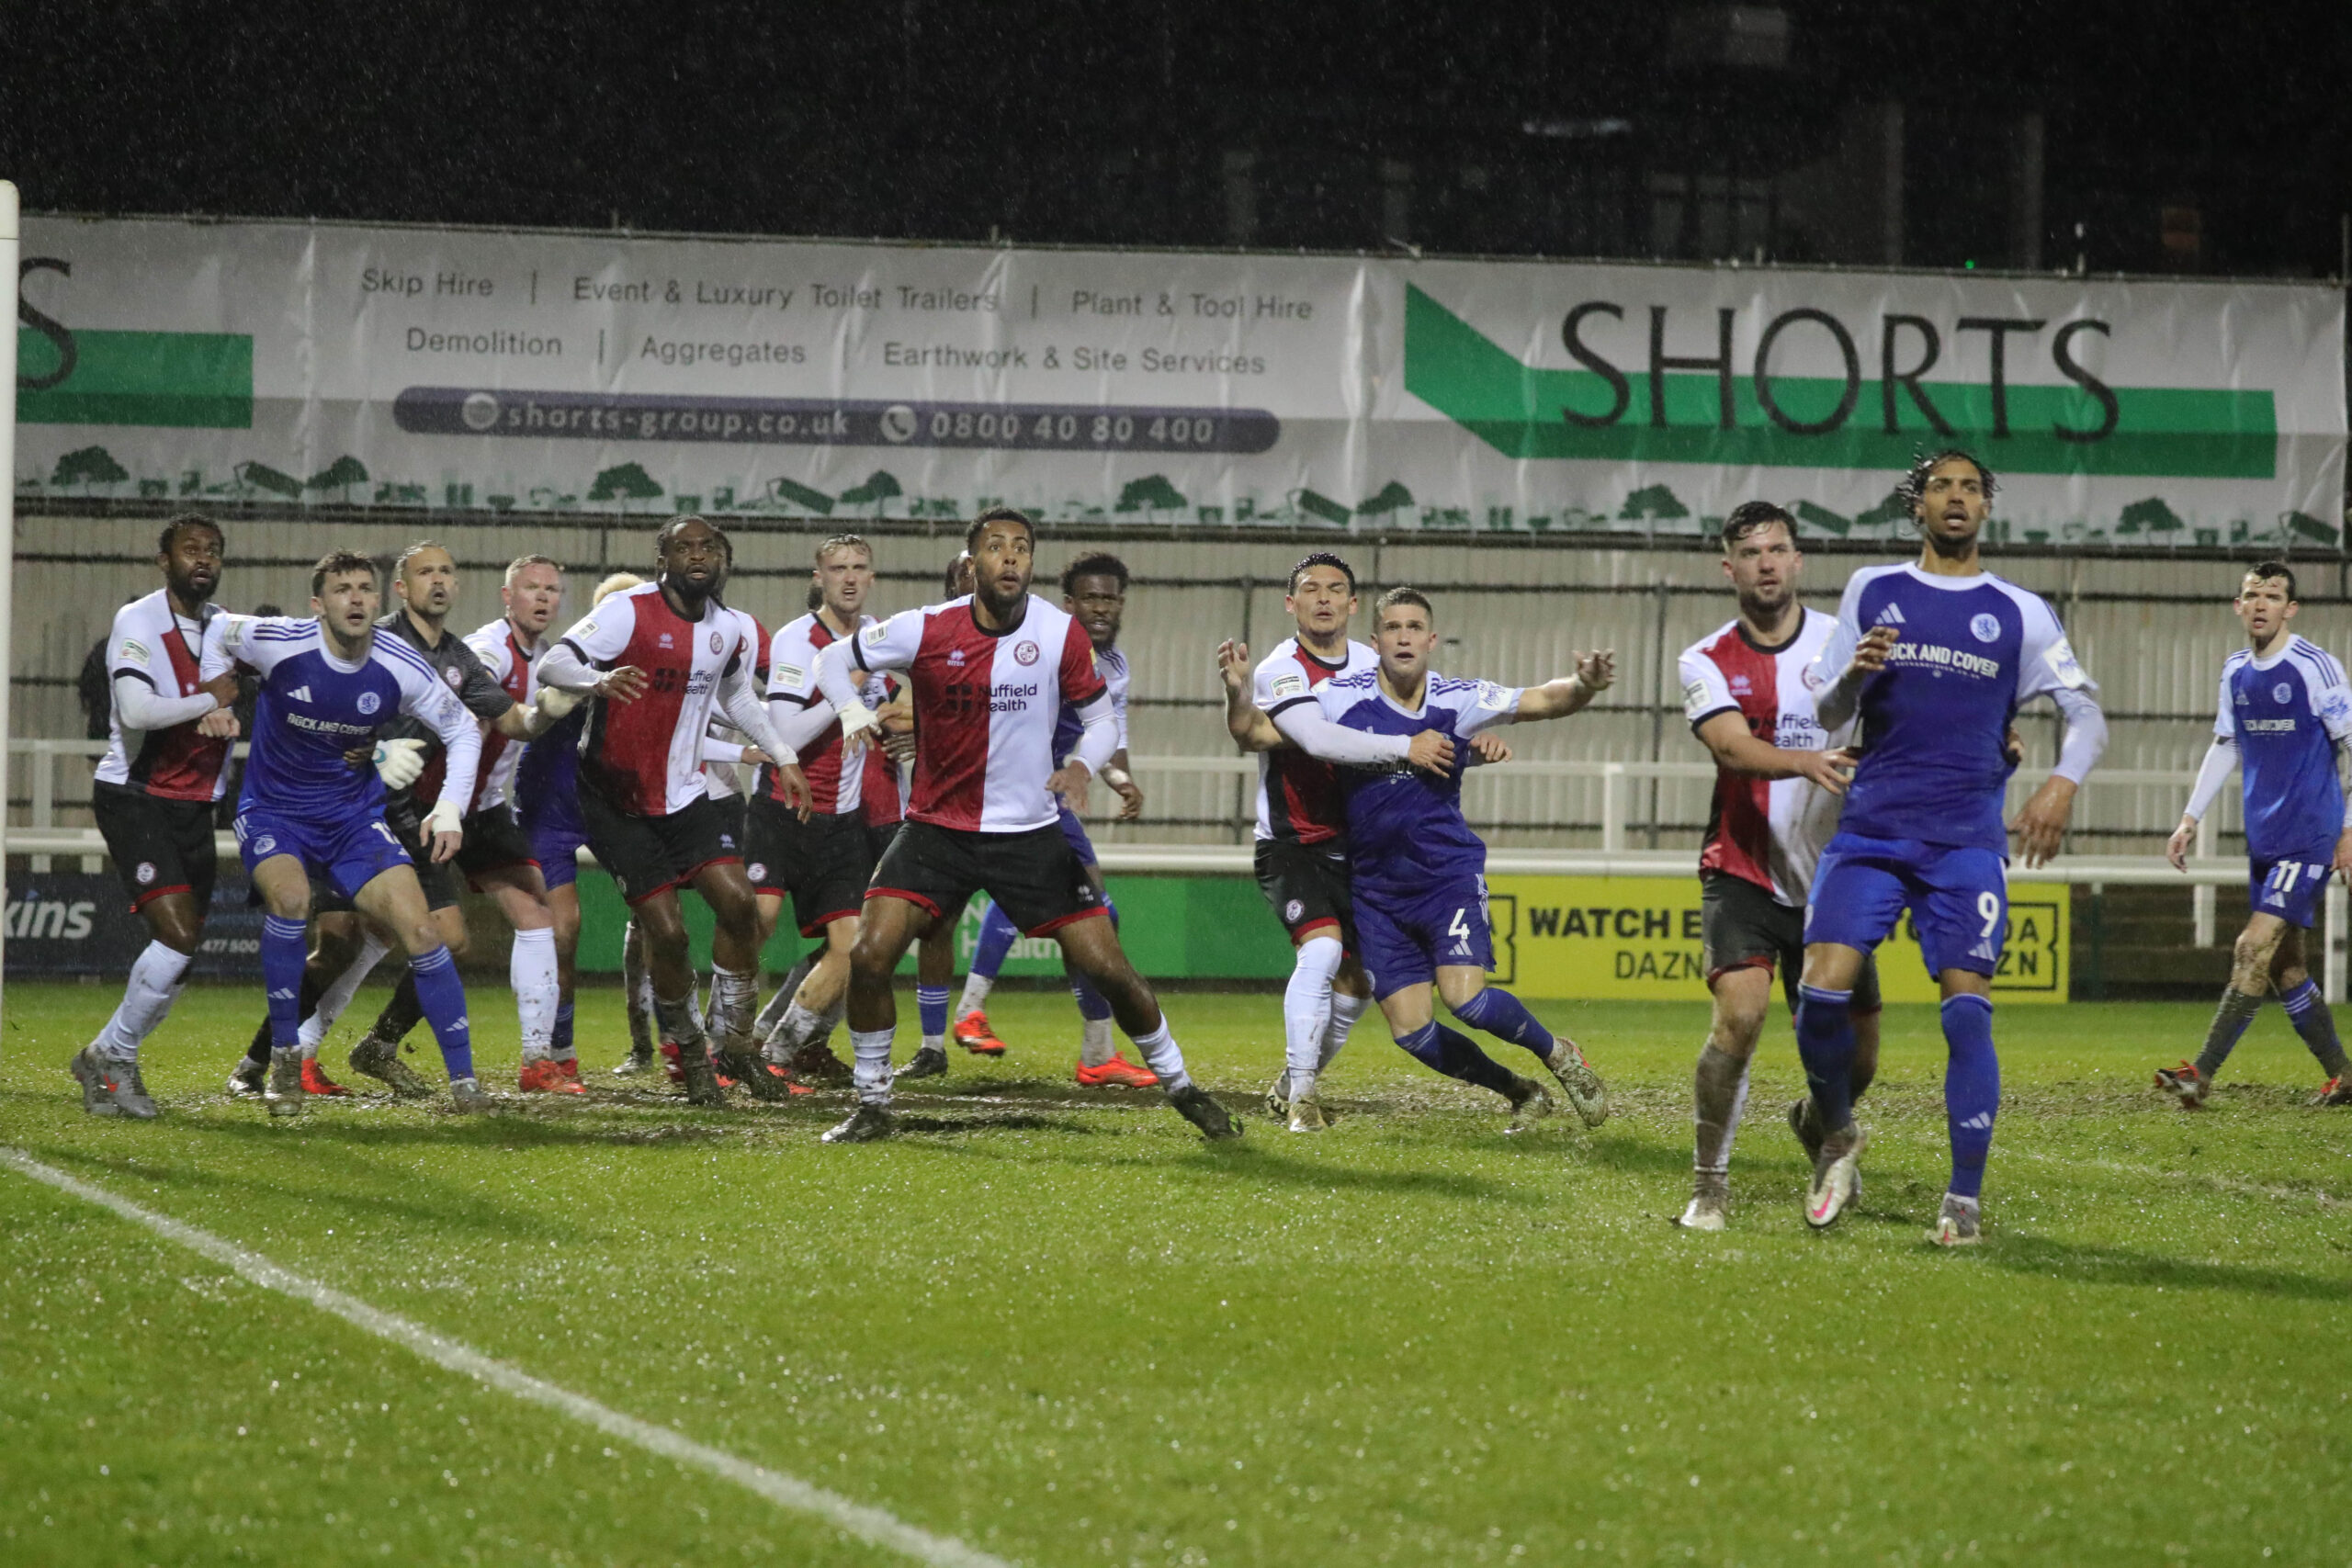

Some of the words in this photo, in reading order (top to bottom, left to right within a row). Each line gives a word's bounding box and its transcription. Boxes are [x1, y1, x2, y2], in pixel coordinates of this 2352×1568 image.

[361, 268, 424, 299] Skip
[436, 271, 493, 297] Hire
[573, 276, 650, 302] Event
[663, 280, 683, 304] &
[696, 281, 794, 310] Luxury
[810, 283, 882, 310] Toilet
[897, 285, 1001, 313] Trailers
[1071, 289, 1143, 316] Plant
[1156, 292, 1174, 317] &
[1189, 292, 1246, 320] Tool
[1255, 295, 1314, 321] Hire
[406, 326, 563, 356] Demolition
[640, 335, 807, 367] Aggregates
[883, 340, 1030, 369] Earthwork
[1043, 345, 1061, 370] &
[1073, 346, 1128, 371] Site
[1141, 346, 1266, 375] Services
[1561, 300, 2120, 444] SHORTS
[508, 400, 849, 439] shorts-group.co.uk
[930, 411, 1020, 440] 0800
[1033, 413, 1078, 442] 40
[1091, 414, 1135, 443] 80
[1148, 416, 1214, 444] 400
[1886, 642, 1918, 660] UCK
[1918, 643, 1952, 664] AND
[1951, 649, 2000, 679] COVER
[1767, 734, 1814, 748] ealth
[2272, 860, 2302, 892] 11
[1448, 908, 1470, 940] 4
[1528, 908, 1670, 938] WATCH
[1977, 891, 2000, 938] 9
[961, 930, 1063, 959] Halth
